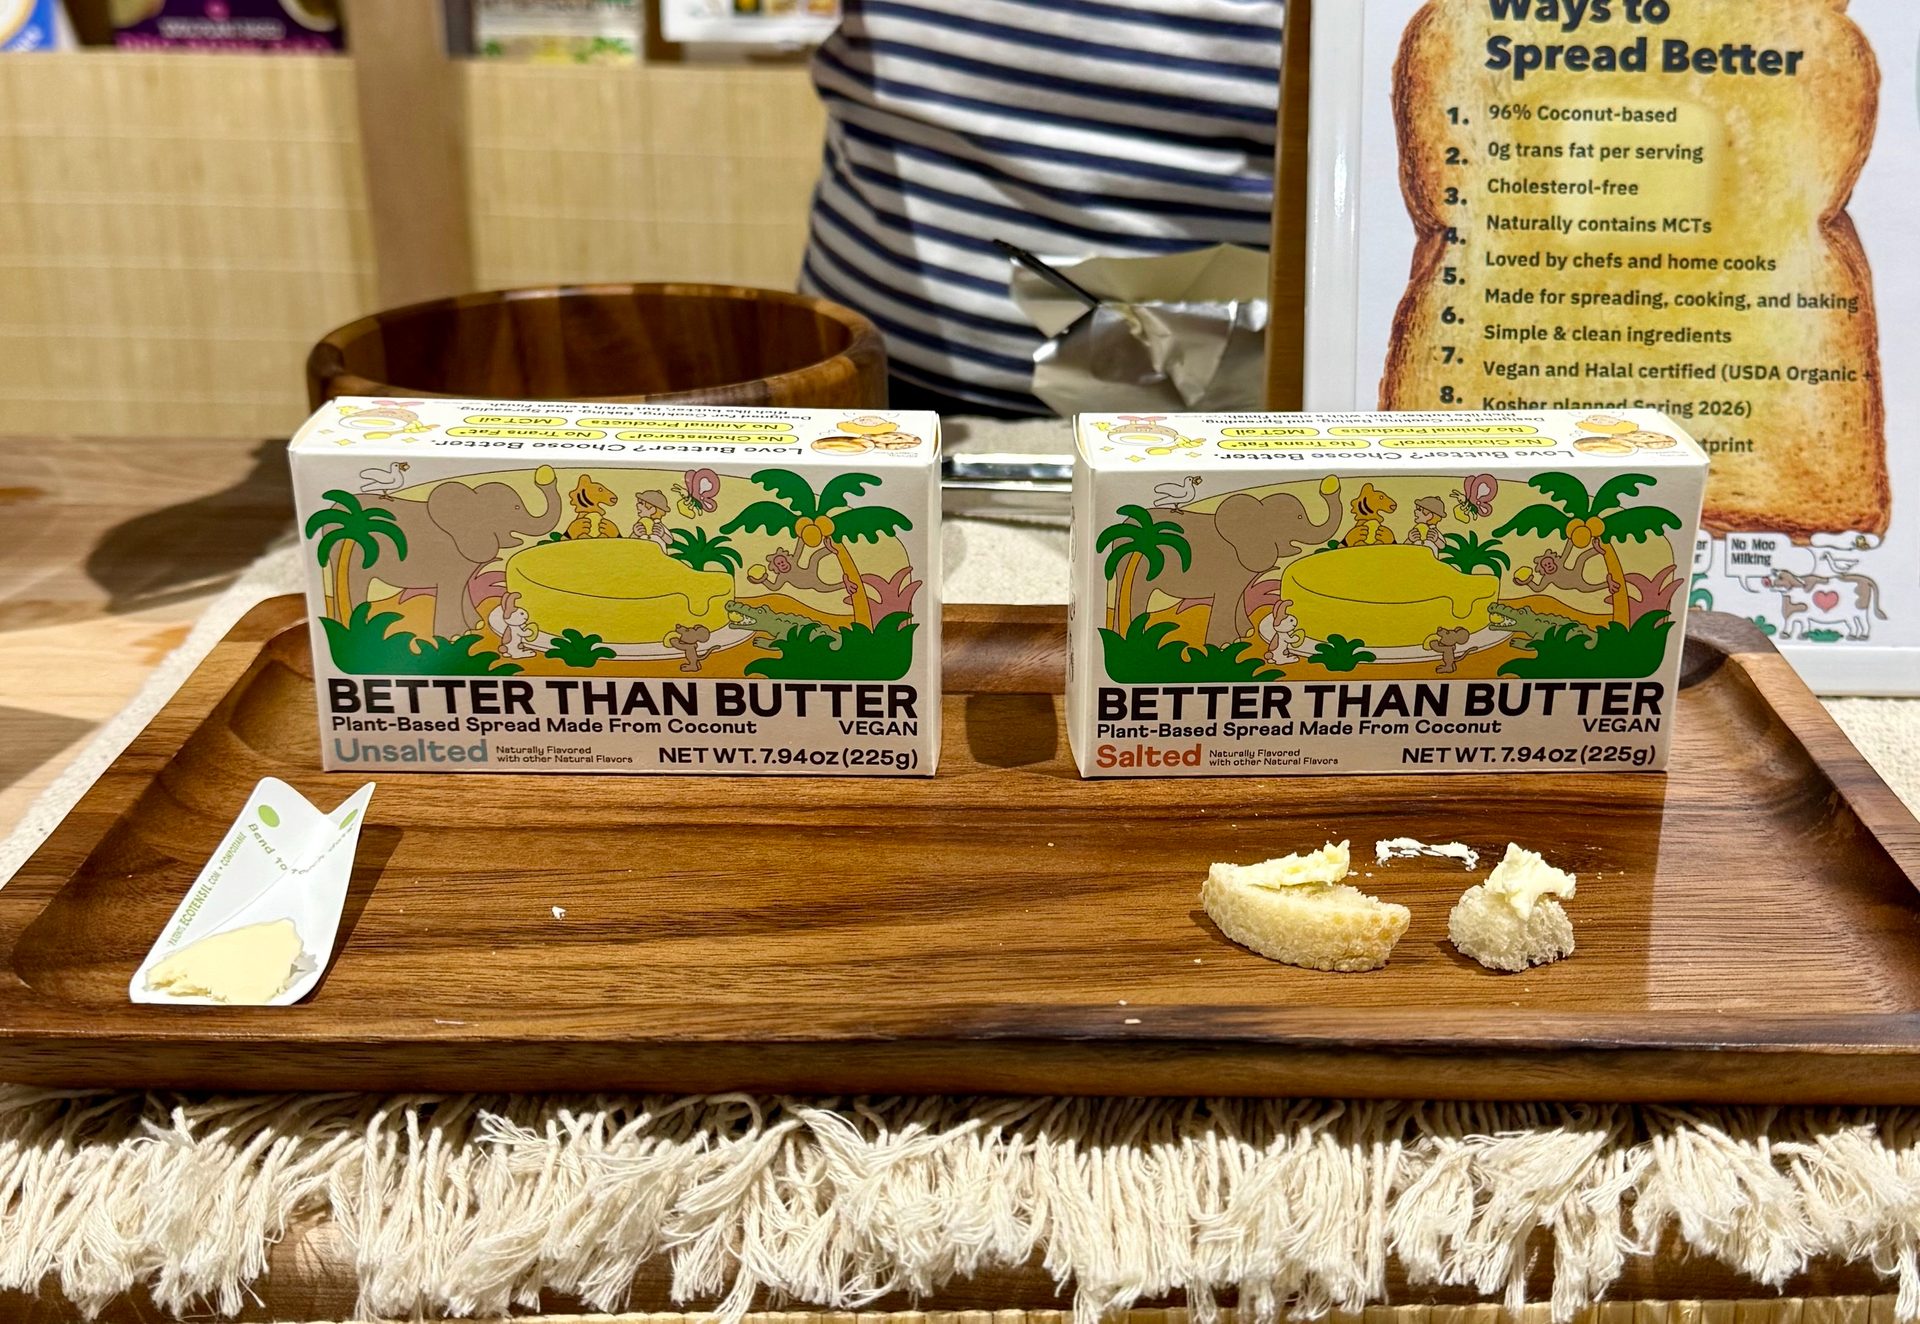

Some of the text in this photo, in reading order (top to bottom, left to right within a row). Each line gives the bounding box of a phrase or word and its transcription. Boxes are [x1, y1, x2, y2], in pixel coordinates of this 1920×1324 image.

[1488, 0, 1671, 32] Ways to
[1484, 35, 1804, 81] Spread Better
[1446, 107, 1470, 126] 1.
[1488, 104, 1678, 123] 96% Coconut-based
[1445, 147, 1469, 165] 2.
[1515, 143, 1564, 158] trans
[1568, 142, 1594, 158] fat
[1599, 145, 1630, 164] per
[1635, 143, 1704, 164] serving
[1443, 187, 1468, 205] 3.
[1487, 178, 1639, 196] Cholesterol-free
[1486, 215, 1712, 234] Naturally contains MCTs
[1442, 227, 1467, 245] 4.
[1485, 252, 1777, 271] Loved by chefs and home cooks
[1442, 267, 1466, 285] 5.
[1484, 288, 1858, 313] Made for spreading, cooking, and baking
[1441, 306, 1465, 324] 6.
[1483, 325, 1732, 346] Simple & clean ingredients
[1441, 347, 1464, 364] 7.
[1483, 361, 1540, 381] Vegan
[1545, 361, 1580, 378] and
[1585, 362, 1634, 379] Halal
[1638, 363, 1716, 380] certified
[1721, 363, 1780, 383] (USDA
[1786, 365, 1857, 384] Organic
[1440, 386, 1463, 405] 8.
[1482, 397, 1547, 411] Kosher
[1698, 400, 1752, 418] 2026)
[591, 419, 679, 428] Products
[1341, 427, 1428, 435] Products
[431, 440, 803, 455] Love Butter? Choose Better.
[1214, 450, 1575, 461] Love Butter? Choose Better.
[1701, 438, 1754, 455] tprint
[1731, 538, 1776, 550] No Moo
[1731, 553, 1771, 566] Milking
[327, 678, 918, 719] BETTER THAN BUTTER
[1098, 681, 1665, 721] BETTER THAN BUTTER
[331, 716, 757, 736] Plant-Based Spread Made From Coconut
[839, 720, 918, 736] VEGAN
[1097, 719, 1502, 740] Plant-Based Spread Made From Coconut
[1582, 718, 1660, 733] VEGAN
[334, 738, 488, 763] Unsalted
[496, 745, 592, 756] Naturally Flavored
[497, 754, 633, 764] with other Natural Flavors
[658, 747, 918, 770] NET WT. 7.94oz (225g)
[1096, 743, 1202, 769] Salted
[1209, 748, 1301, 758] Naturally Flavored
[1401, 744, 1656, 766] NET WT. 7.94oz (225g)
[1209, 756, 1339, 766] with other Natural Flavors
[248, 823, 276, 855] Bend
